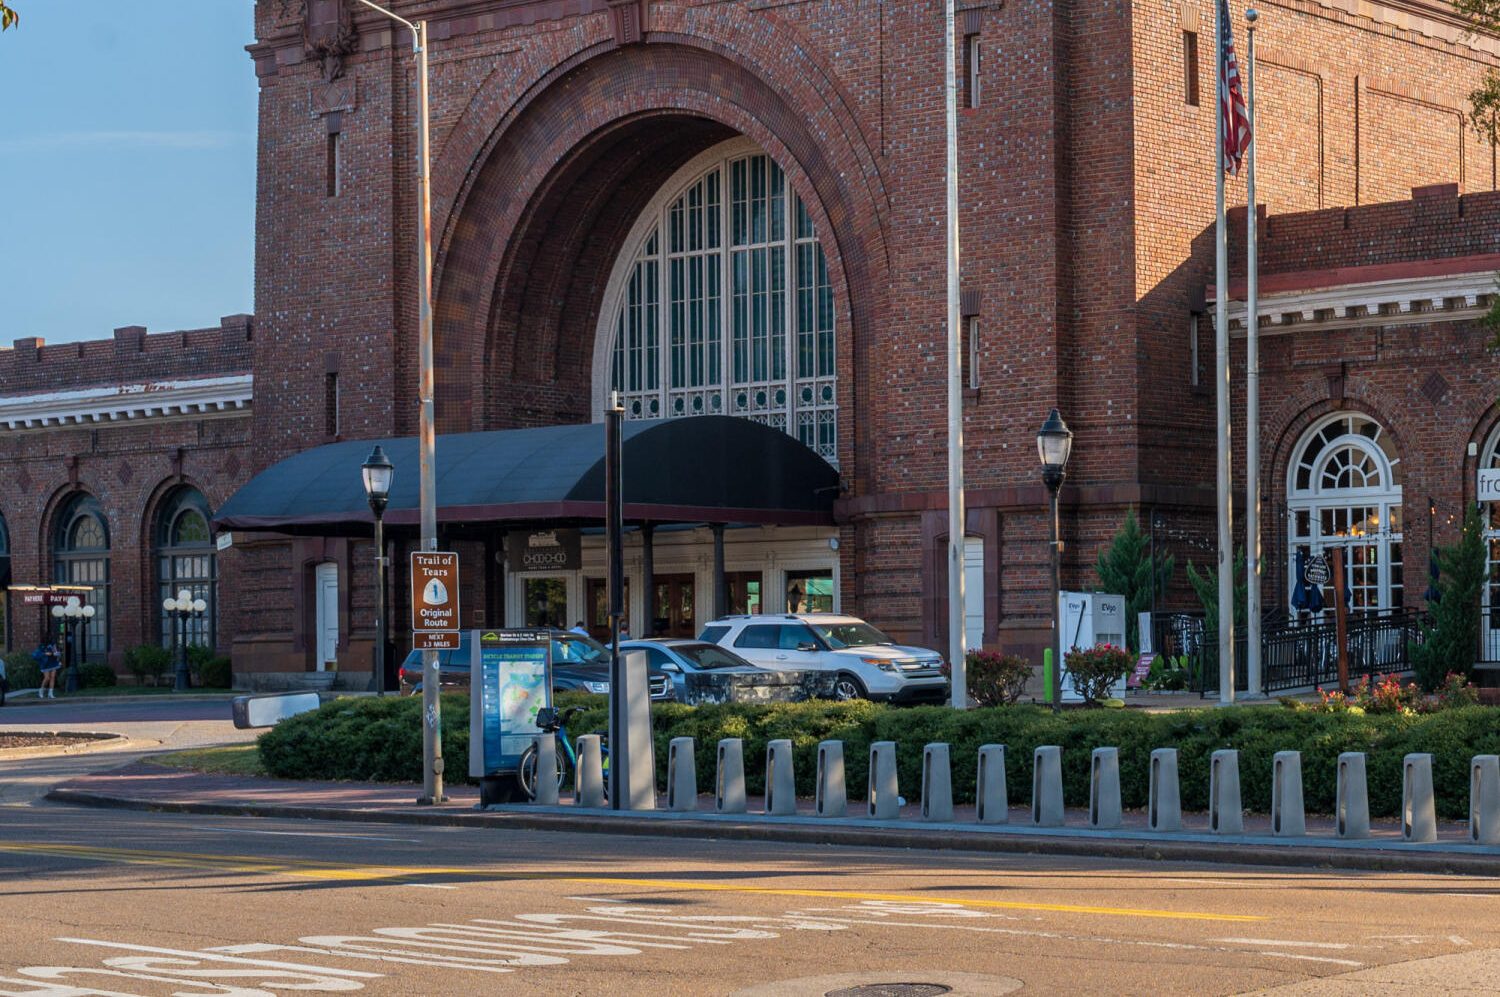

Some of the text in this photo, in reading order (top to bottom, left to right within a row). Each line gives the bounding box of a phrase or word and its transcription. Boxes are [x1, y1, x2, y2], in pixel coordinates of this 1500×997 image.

[417, 555, 453, 565] Trail of
[422, 568, 448, 576] Tears
[1101, 603, 1116, 612] EVgo
[420, 608, 452, 618] Original
[424, 619, 448, 627] Route
